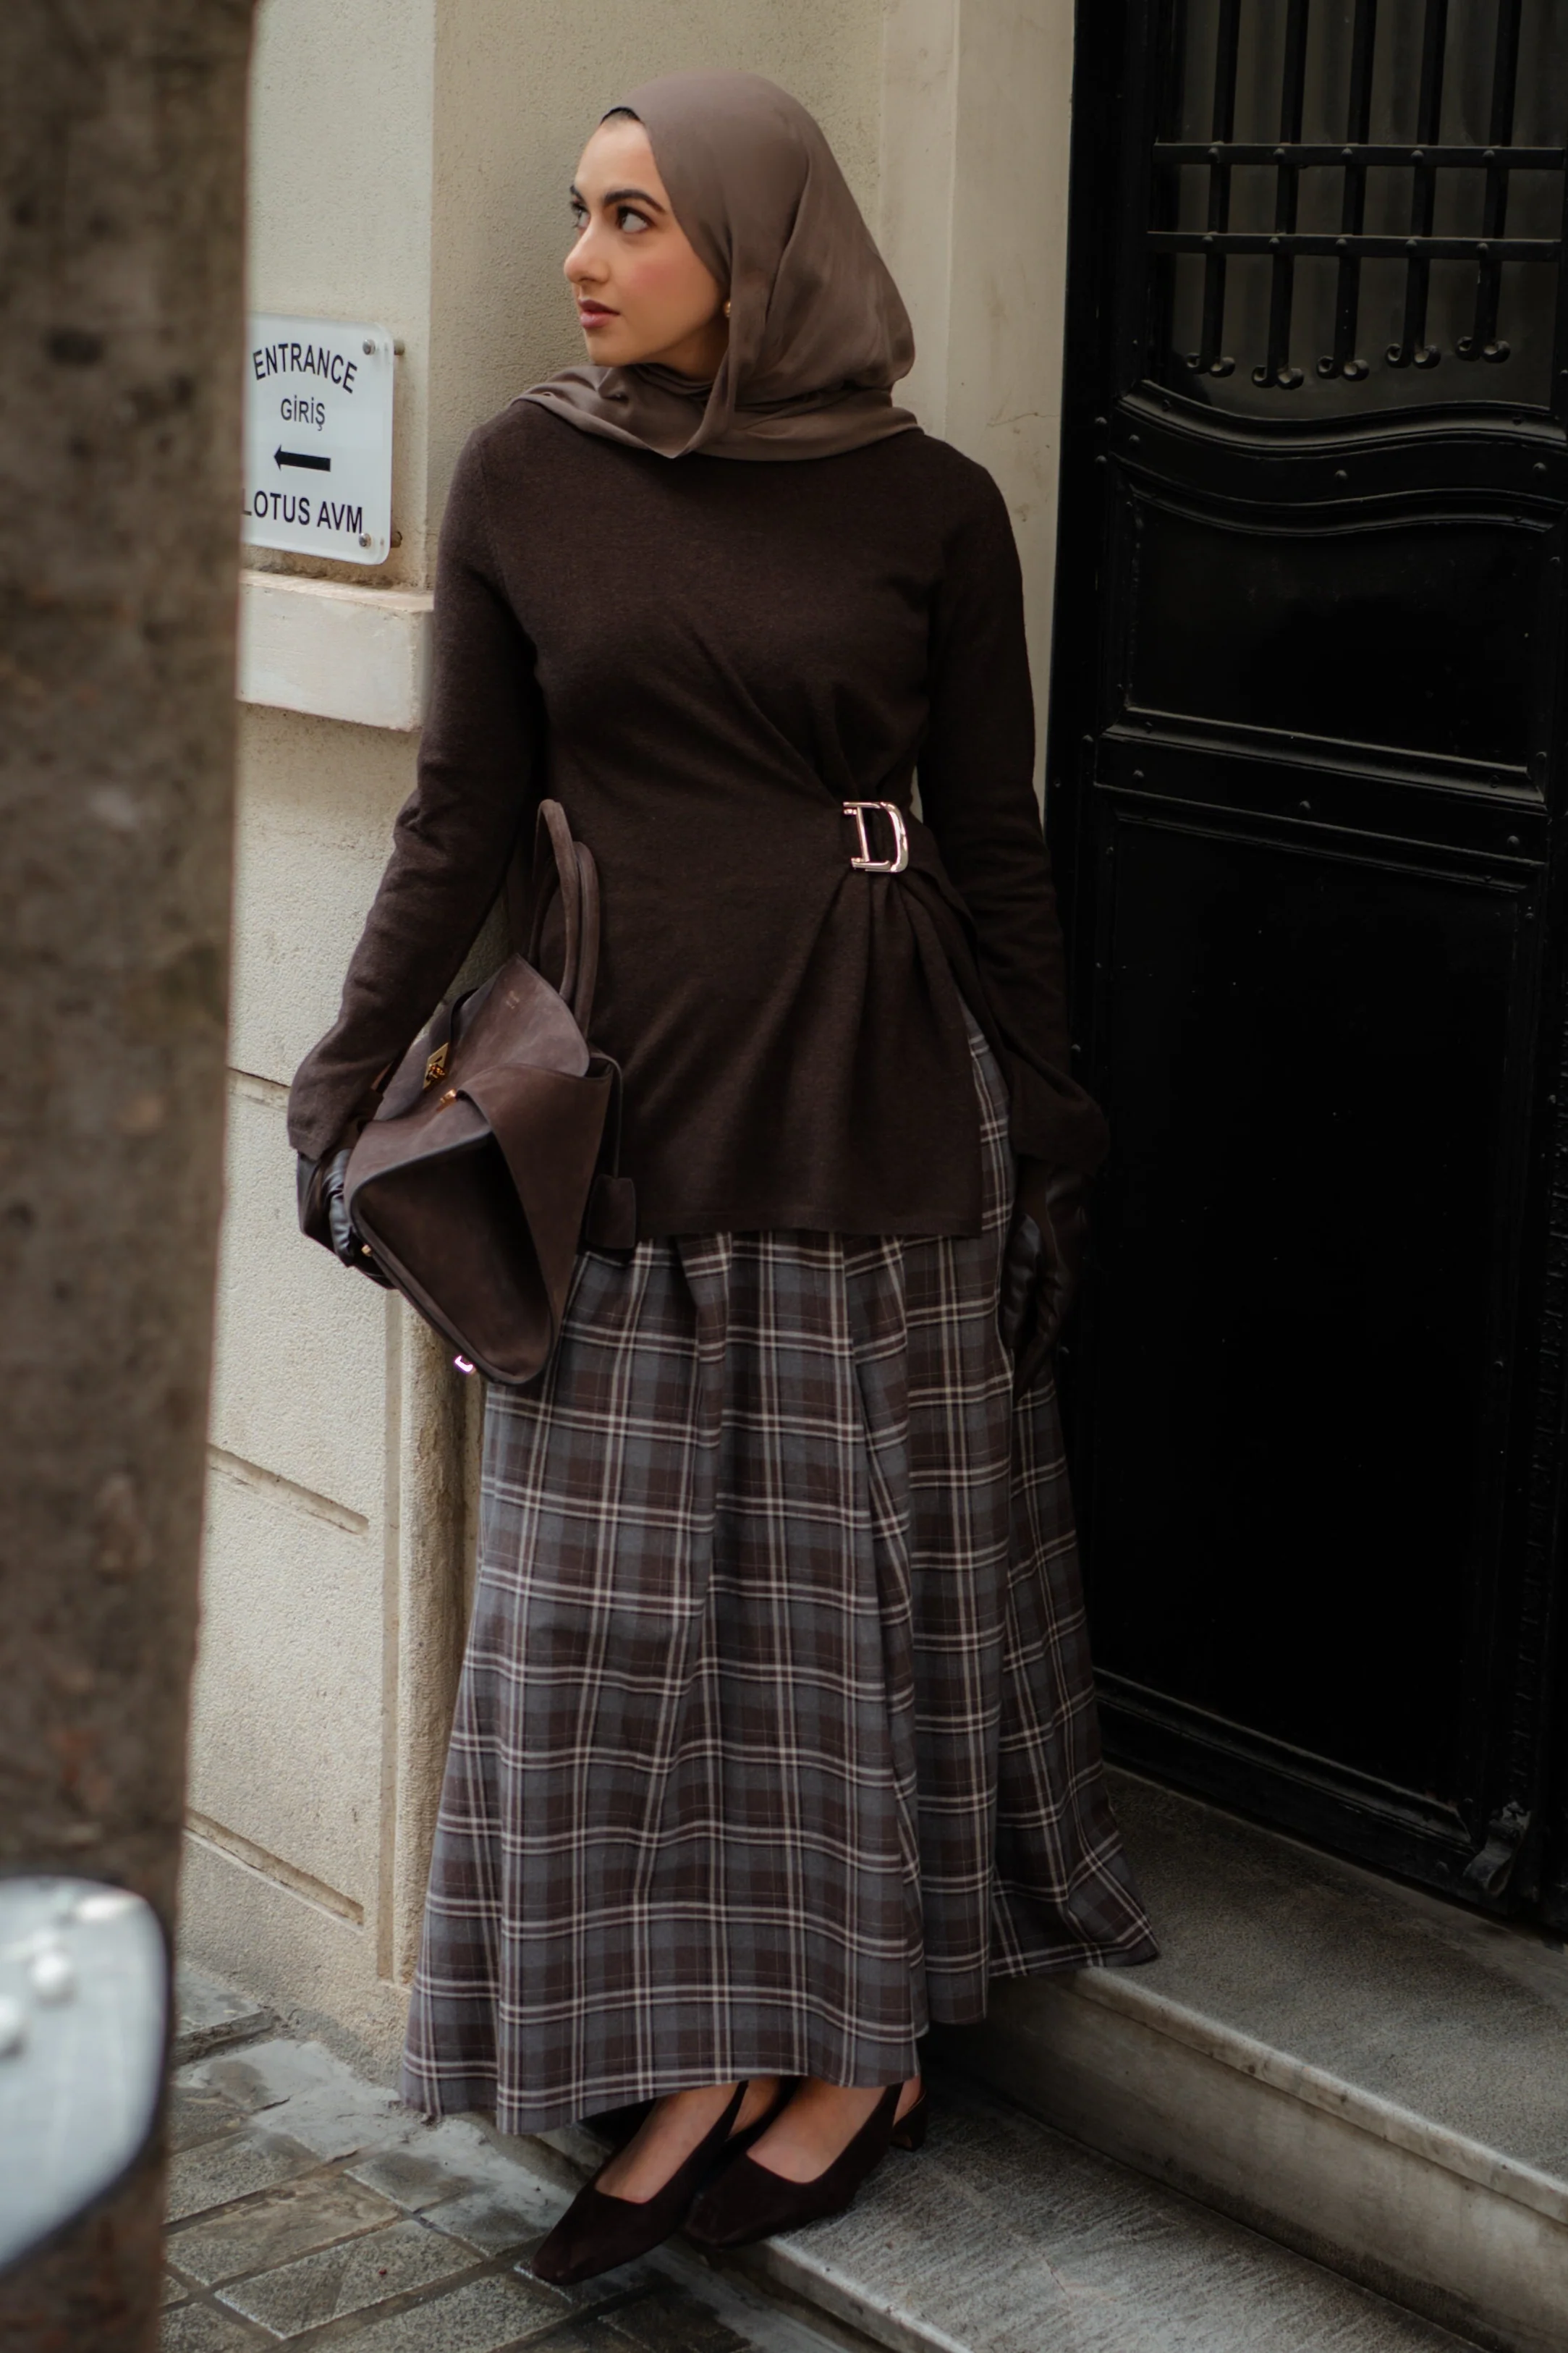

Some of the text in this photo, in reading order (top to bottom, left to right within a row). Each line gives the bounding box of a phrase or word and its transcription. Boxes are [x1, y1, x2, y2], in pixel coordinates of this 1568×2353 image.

[253, 342, 357, 393] ENTRANCE
[281, 394, 325, 431] GİRİŞ
[317, 501, 363, 533] AVM
